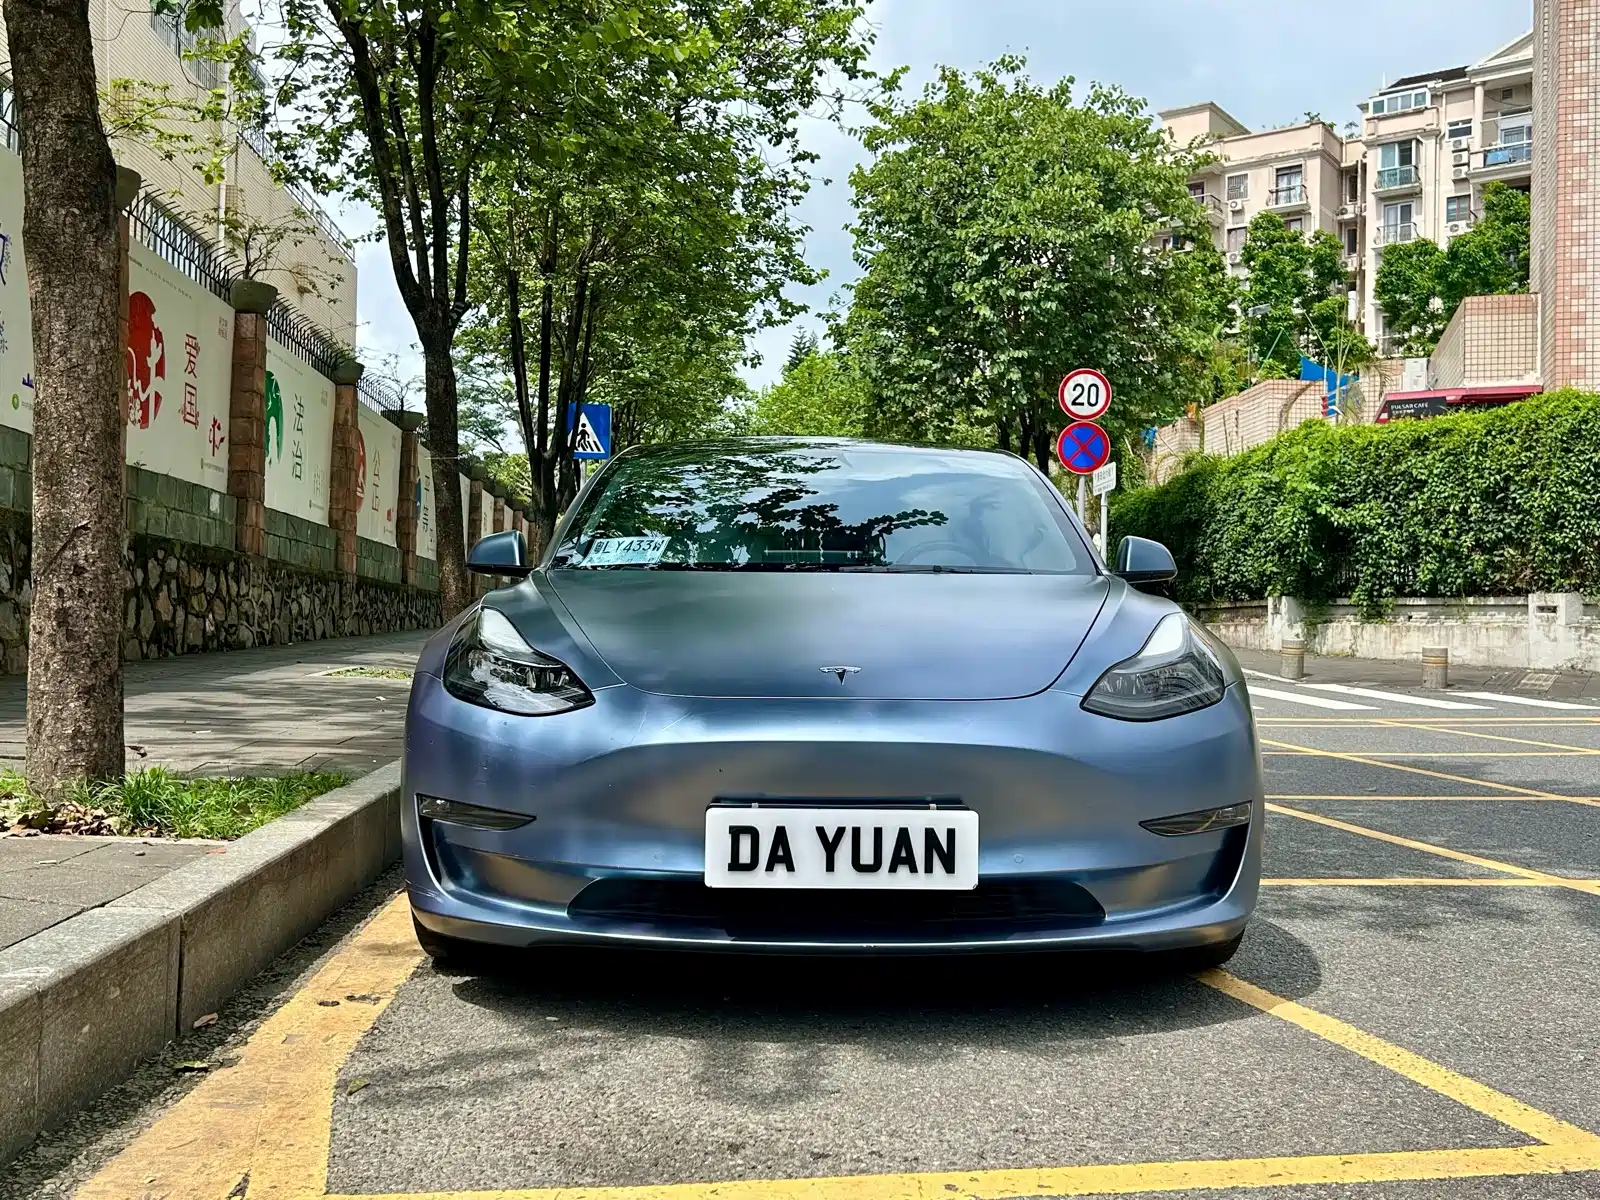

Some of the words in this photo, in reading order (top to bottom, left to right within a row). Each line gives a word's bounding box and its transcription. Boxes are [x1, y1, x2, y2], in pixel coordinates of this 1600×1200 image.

[184, 333, 200, 431] 爱国
[1071, 383, 1099, 406] 20
[292, 393, 305, 481] 法治
[727, 825, 796, 872] DA
[815, 826, 956, 874] YUAN
